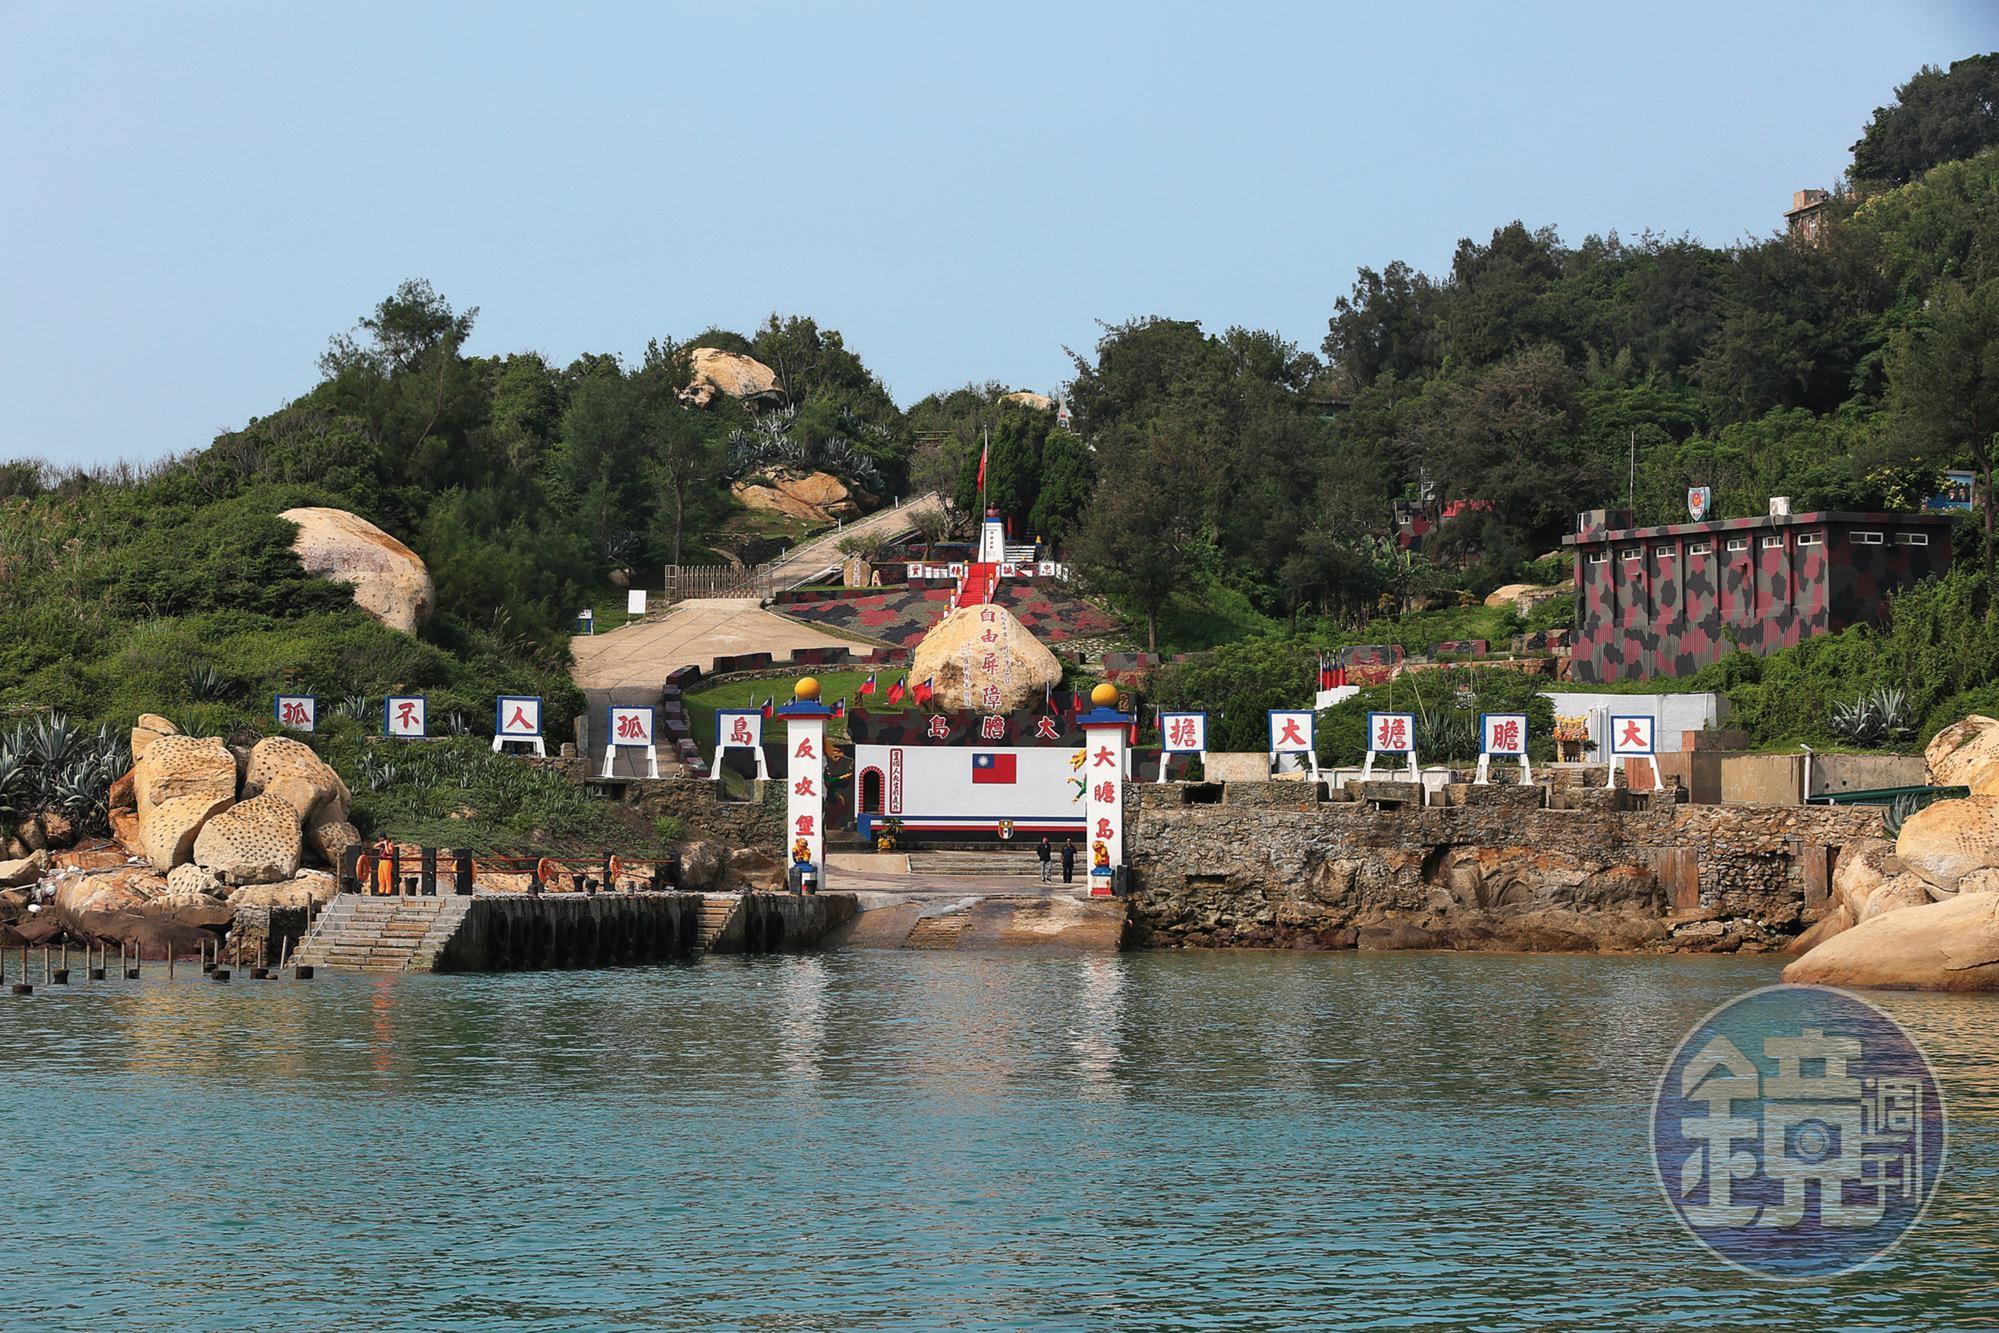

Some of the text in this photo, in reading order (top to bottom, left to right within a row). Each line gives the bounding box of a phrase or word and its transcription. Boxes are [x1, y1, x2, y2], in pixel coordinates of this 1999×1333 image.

[980, 608, 1001, 710] 自由屏障
[282, 702, 311, 724] 孤
[399, 702, 420, 728] 不
[509, 706, 534, 729] 人
[617, 715, 647, 739] 孤
[731, 715, 753, 746] 島
[1168, 716, 1197, 748] 擔
[1279, 717, 1307, 746] 大
[1377, 717, 1407, 750] 擔
[1492, 718, 1520, 751] 膽
[1621, 719, 1648, 748] 大
[1092, 745, 1116, 840] 大膽島
